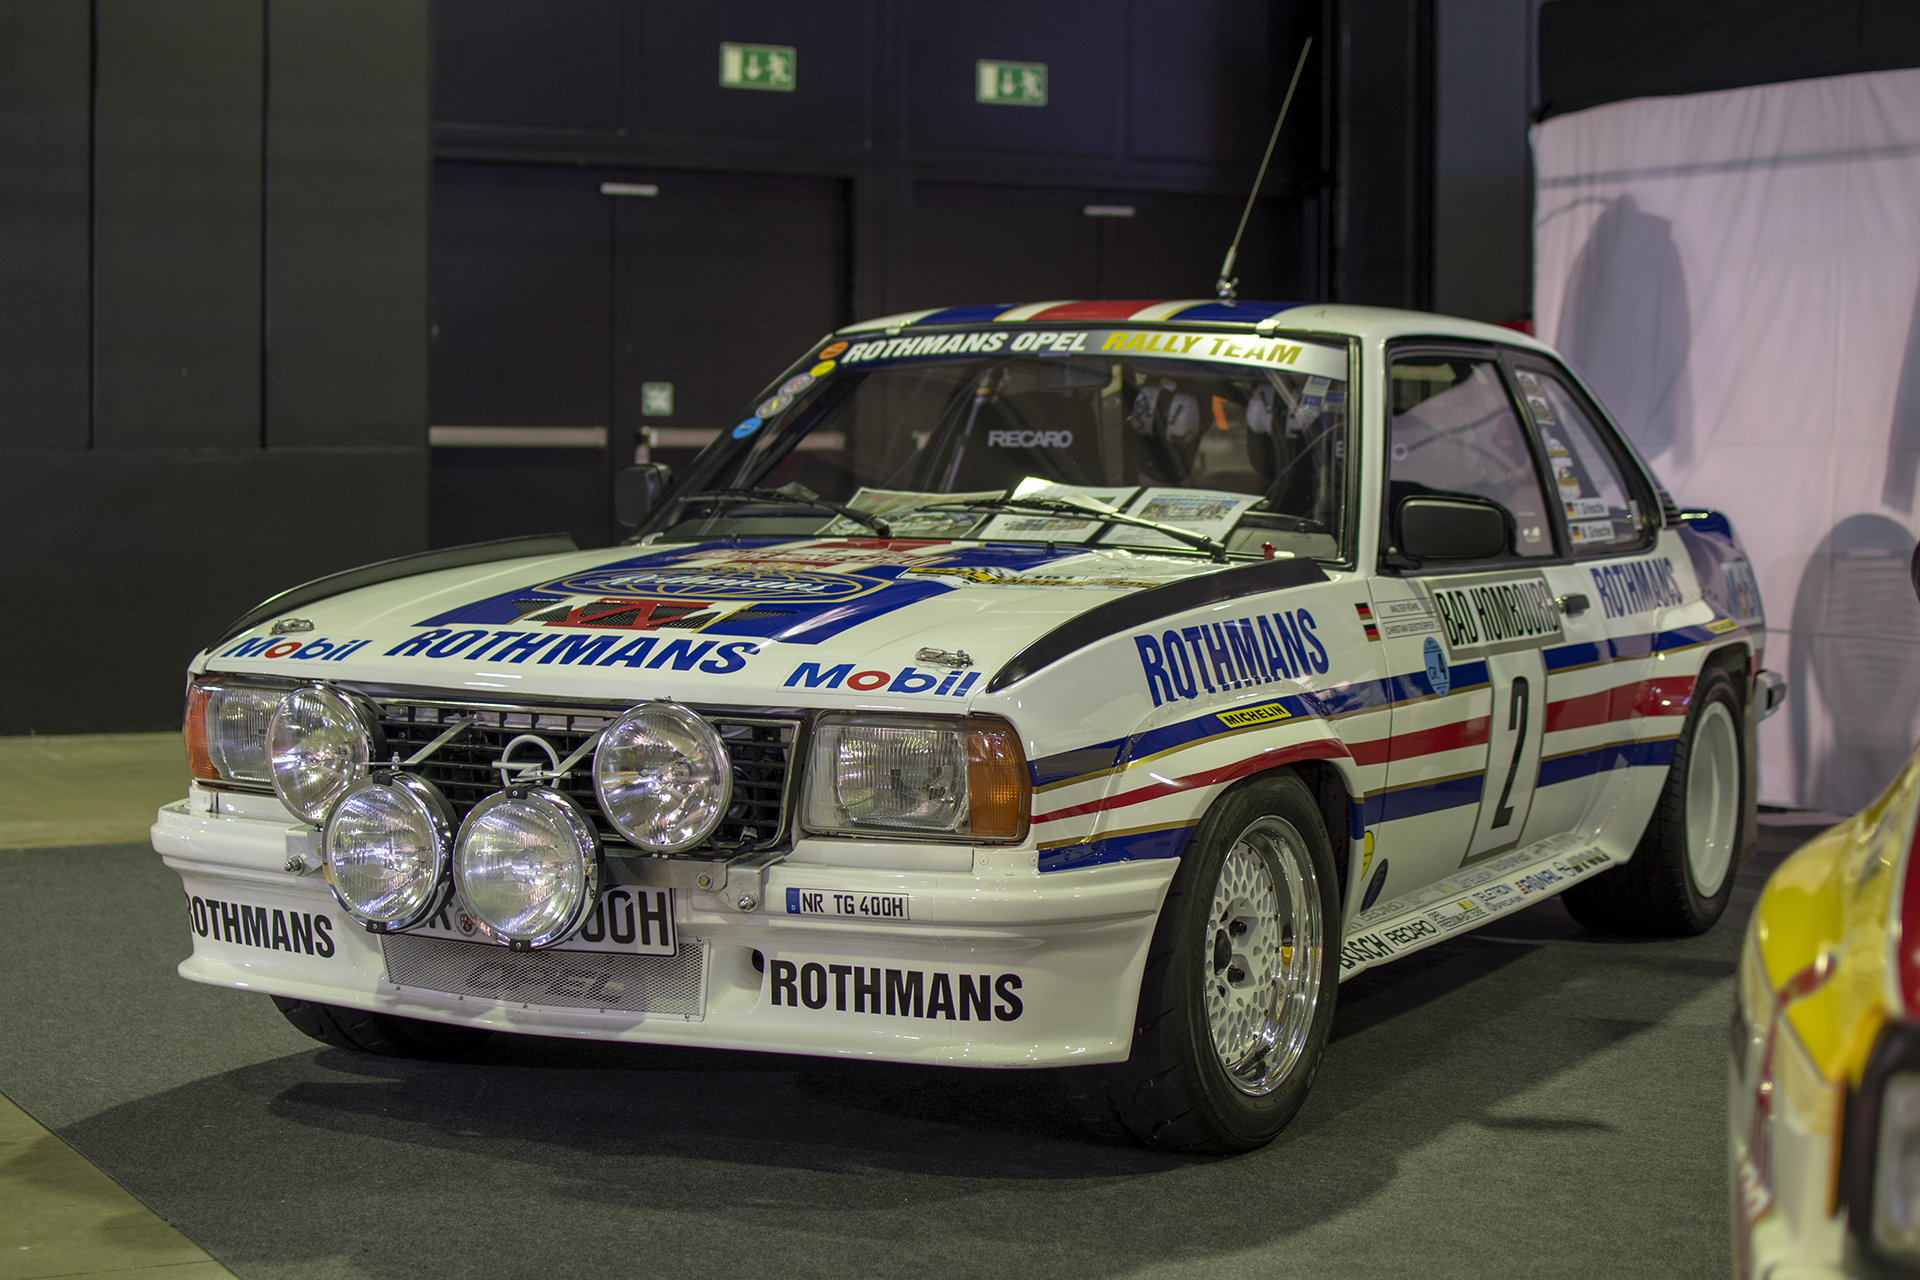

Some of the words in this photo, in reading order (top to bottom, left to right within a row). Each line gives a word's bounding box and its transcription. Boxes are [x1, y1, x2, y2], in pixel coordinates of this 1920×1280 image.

[841, 331, 1003, 365] ROTHMANS
[1009, 331, 1088, 353] OPEL
[1101, 331, 1204, 356] RALLY
[1209, 335, 1303, 366] TEAM
[988, 429, 1073, 449] RECARO
[586, 573, 835, 593] Rothmans
[1589, 557, 1683, 619] ROTHMANS
[1434, 590, 1479, 647] BAD
[1469, 580, 1560, 642] HOMBOURG
[219, 636, 375, 662] Mobil
[382, 628, 763, 675] ROTHMANS
[1133, 607, 1330, 709] ROTHMANS
[1437, 652, 1448, 681] 4
[782, 661, 983, 699] Mobil
[1222, 704, 1286, 727] MICHELIN
[1490, 676, 1530, 831] 2
[574, 888, 670, 947] 00H
[801, 890, 825, 914] NR
[834, 893, 859, 916] TG
[859, 895, 904, 918] 400H
[1340, 933, 1395, 970] BOSCH
[1384, 919, 1437, 947] RECARO
[769, 958, 1025, 1023] ROTHMANS
